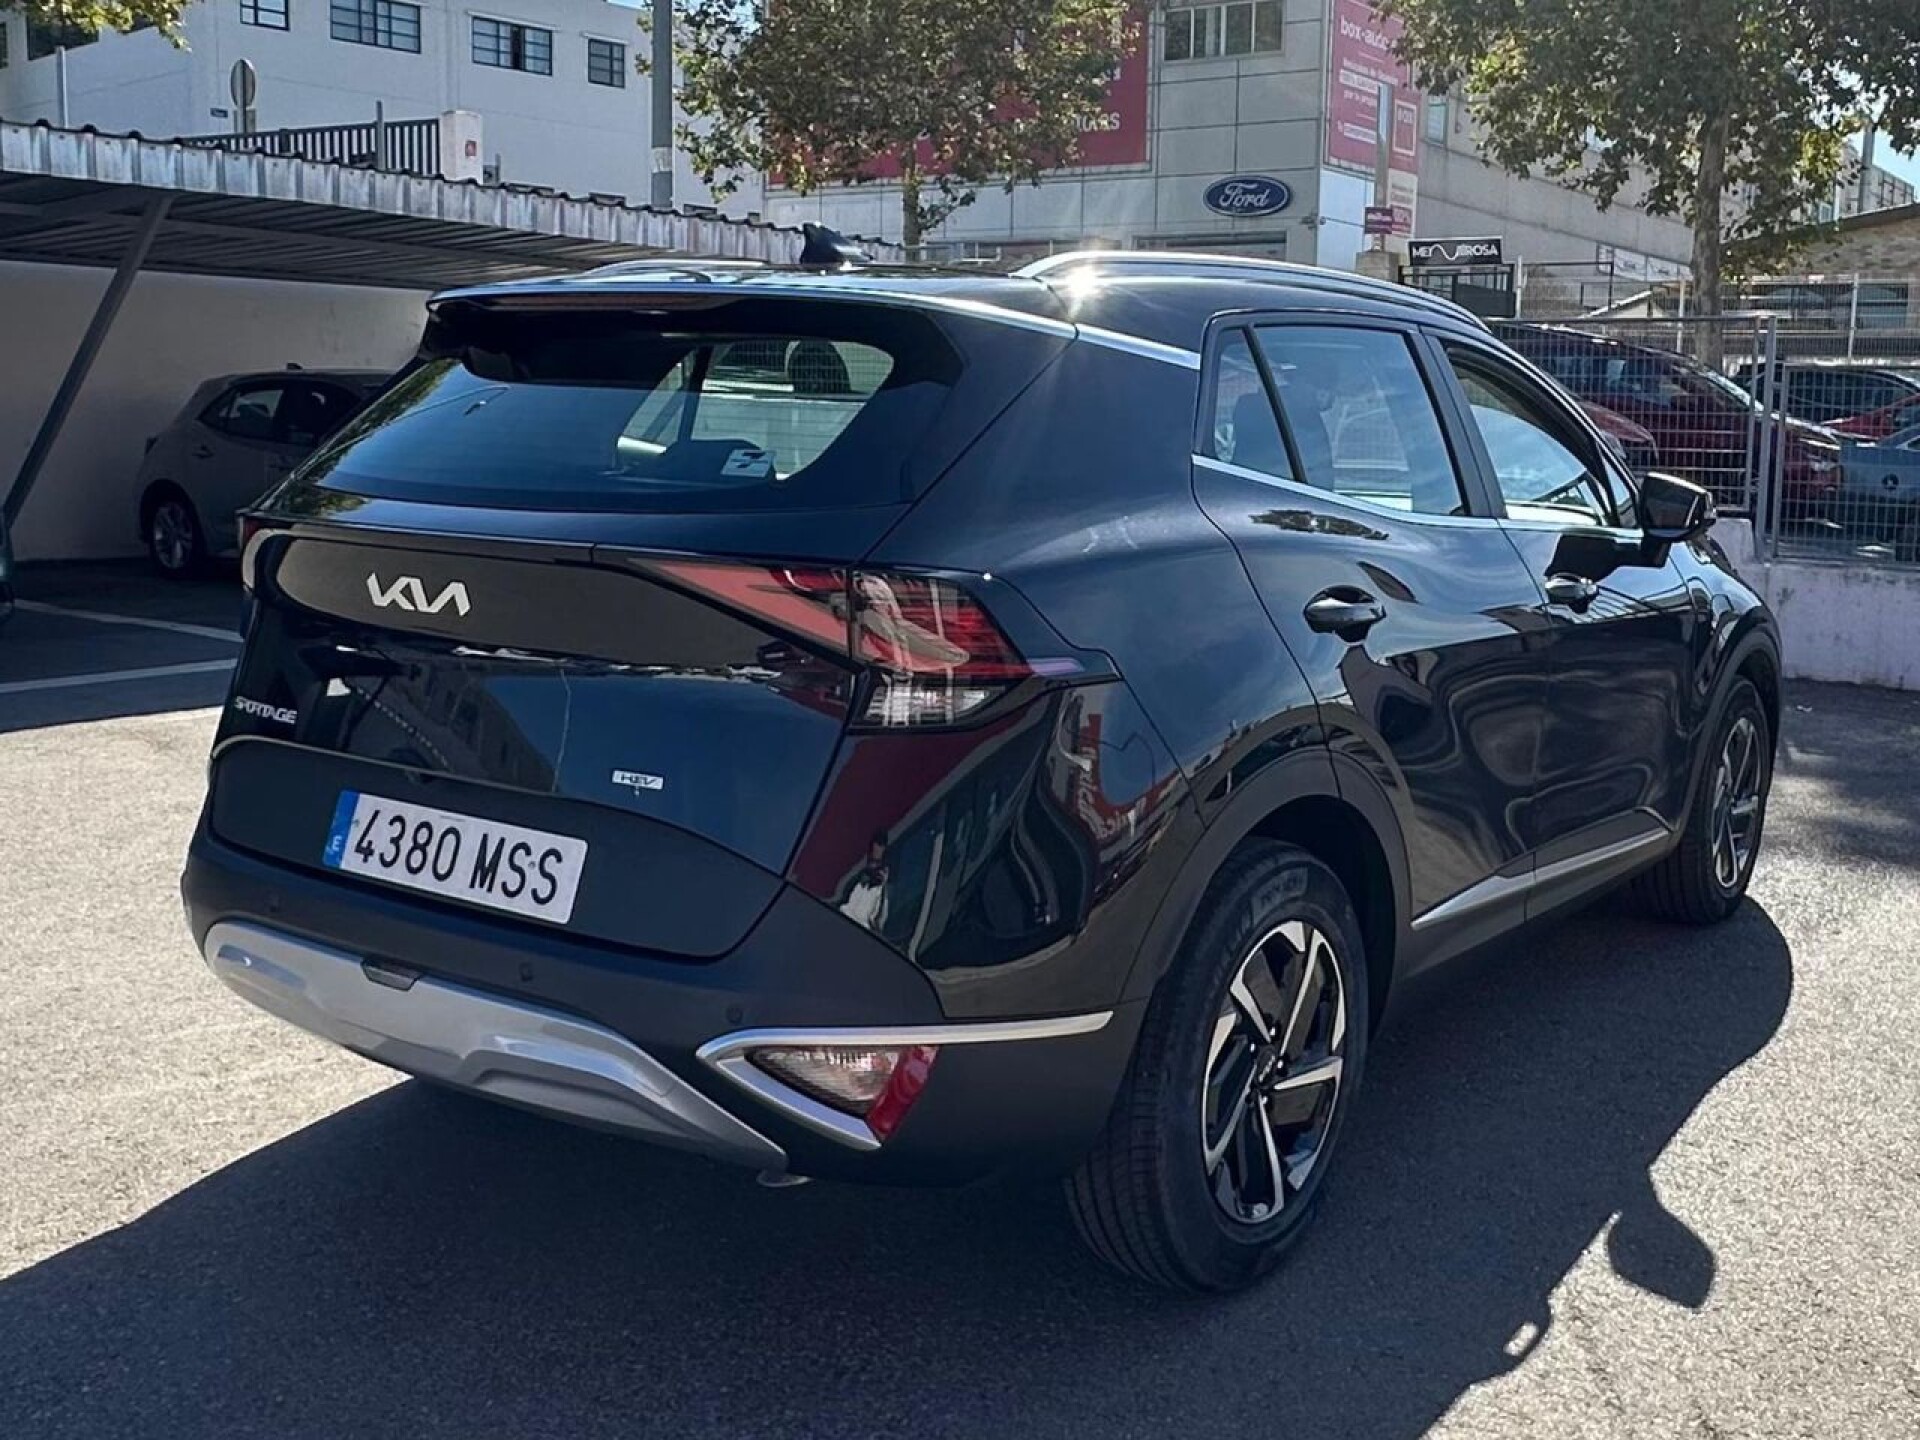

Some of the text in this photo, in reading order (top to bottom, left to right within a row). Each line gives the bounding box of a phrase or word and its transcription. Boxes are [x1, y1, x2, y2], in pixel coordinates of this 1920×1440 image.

[1220, 182, 1271, 208] Ford
[367, 572, 471, 617] KIA
[332, 835, 343, 852] E
[354, 809, 563, 906] 4380 MSS
